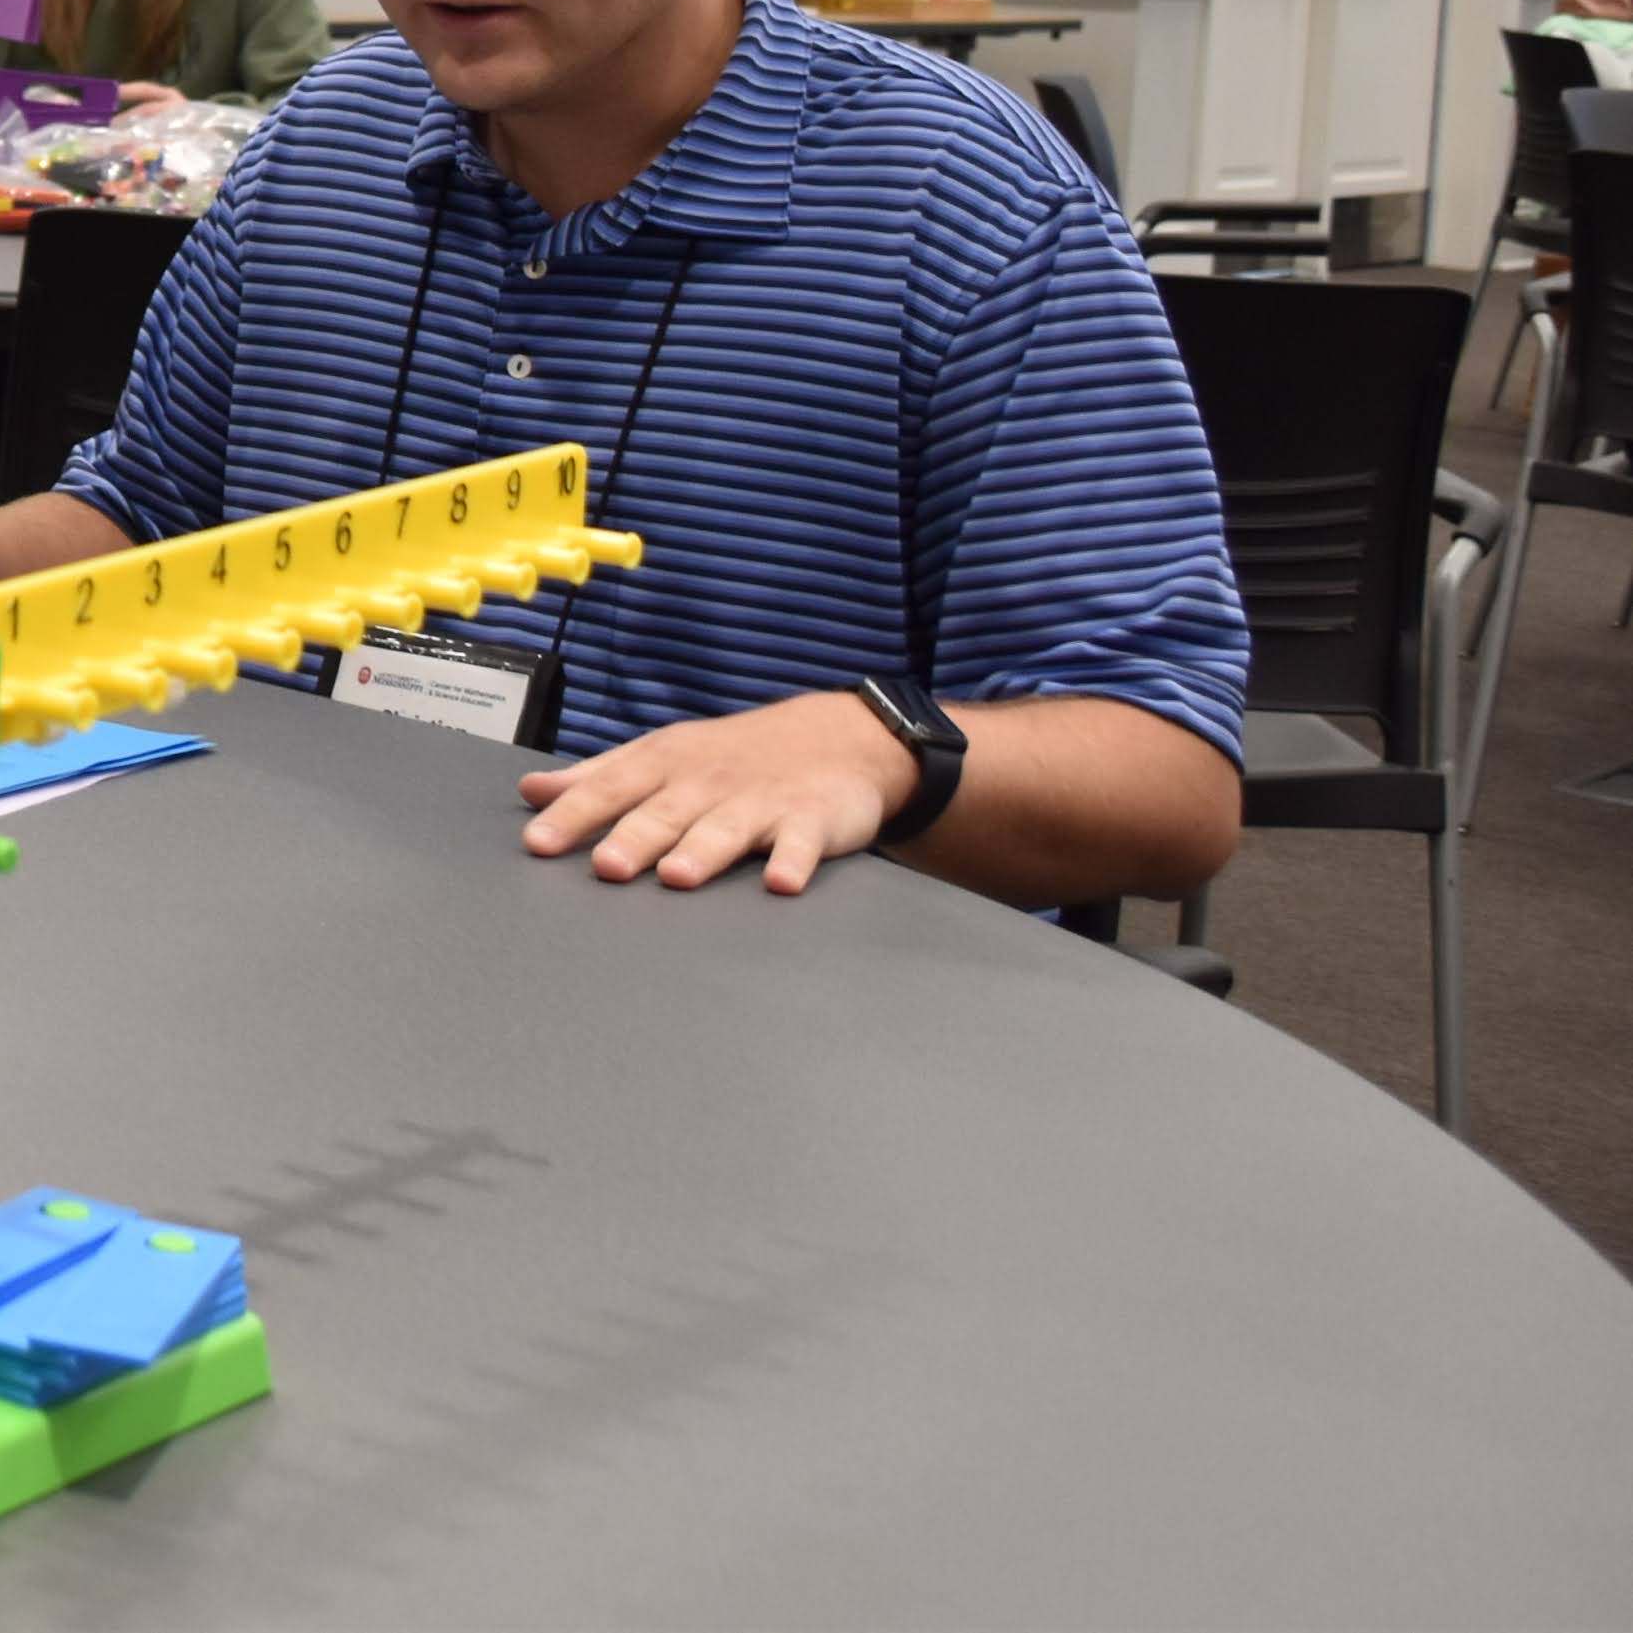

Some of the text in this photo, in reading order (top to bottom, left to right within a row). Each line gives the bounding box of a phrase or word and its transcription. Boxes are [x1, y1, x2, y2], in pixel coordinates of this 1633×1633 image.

[7, 596, 19, 642] 1
[75, 576, 95, 626] 2
[144, 559, 163, 606] 3
[210, 542, 229, 586] 4
[274, 526, 292, 570] 5
[335, 510, 352, 555] 6
[395, 496, 412, 540] 7
[449, 481, 468, 525] 8
[505, 468, 522, 511] 9
[556, 456, 578, 498] 10
